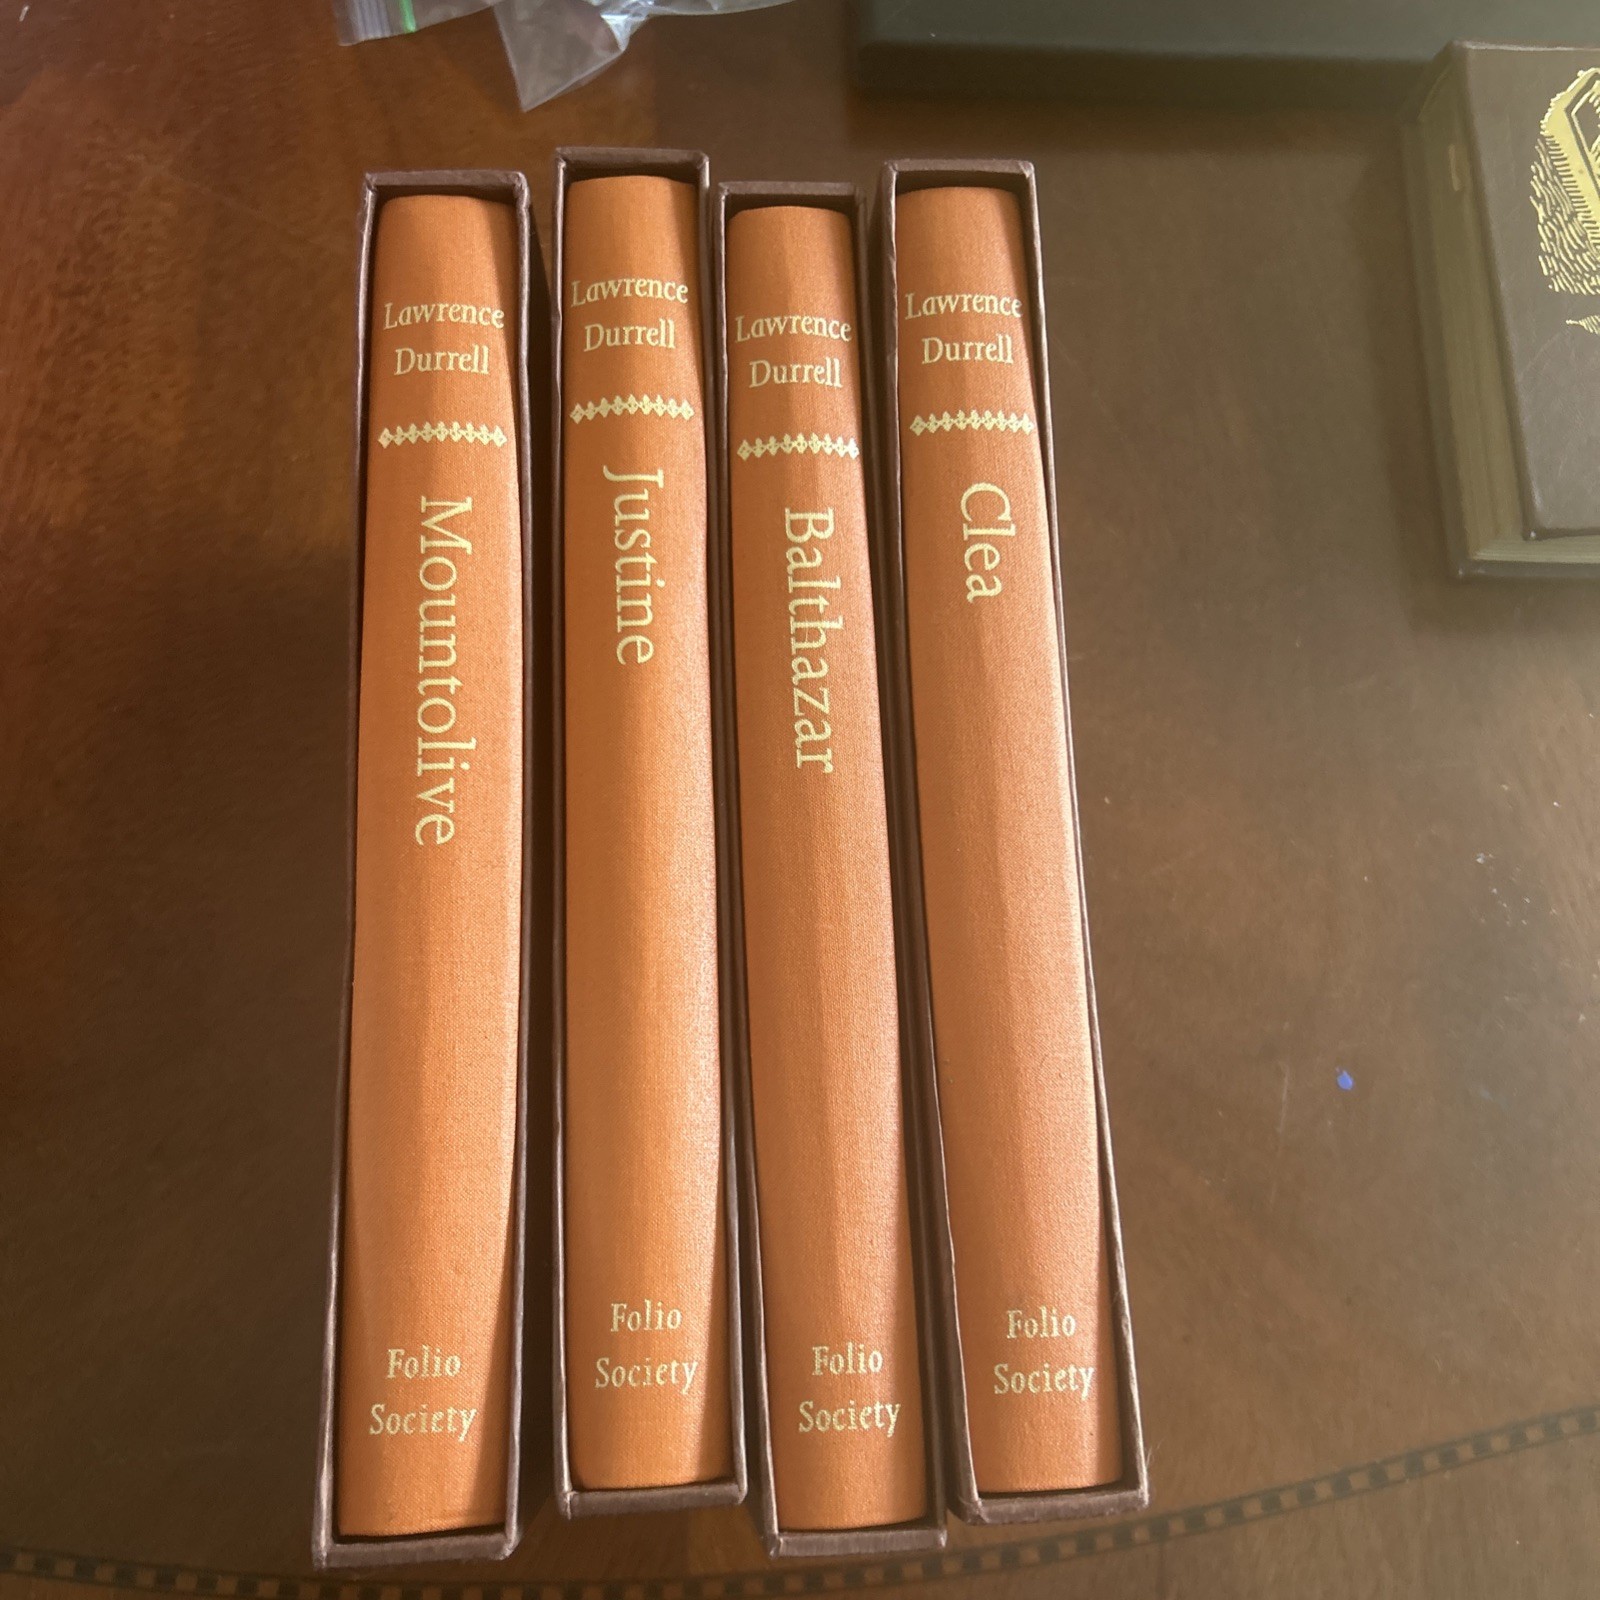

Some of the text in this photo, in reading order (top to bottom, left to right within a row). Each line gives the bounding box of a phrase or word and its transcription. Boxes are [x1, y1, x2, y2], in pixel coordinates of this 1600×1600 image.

[571, 278, 689, 307] Lawrence
[904, 292, 1021, 320] Lawrence
[383, 302, 505, 330] Lawrence
[735, 314, 852, 342] Lawrence
[583, 318, 676, 352] Durrell
[921, 334, 1014, 365] Durrell
[393, 343, 490, 376] Durrell
[748, 356, 843, 388] Durrell
[959, 481, 1016, 604] Clea
[602, 464, 666, 666] Justine
[784, 506, 844, 774] Balthazar
[414, 494, 477, 846] Mountolive
[610, 1298, 683, 1333] Folio
[1006, 1305, 1077, 1339] Folio
[386, 1344, 461, 1380] Folio
[594, 1356, 699, 1395] Society
[811, 1342, 884, 1376] Folio
[993, 1361, 1095, 1401] Society
[368, 1403, 477, 1442] Society
[798, 1399, 901, 1437] Society
